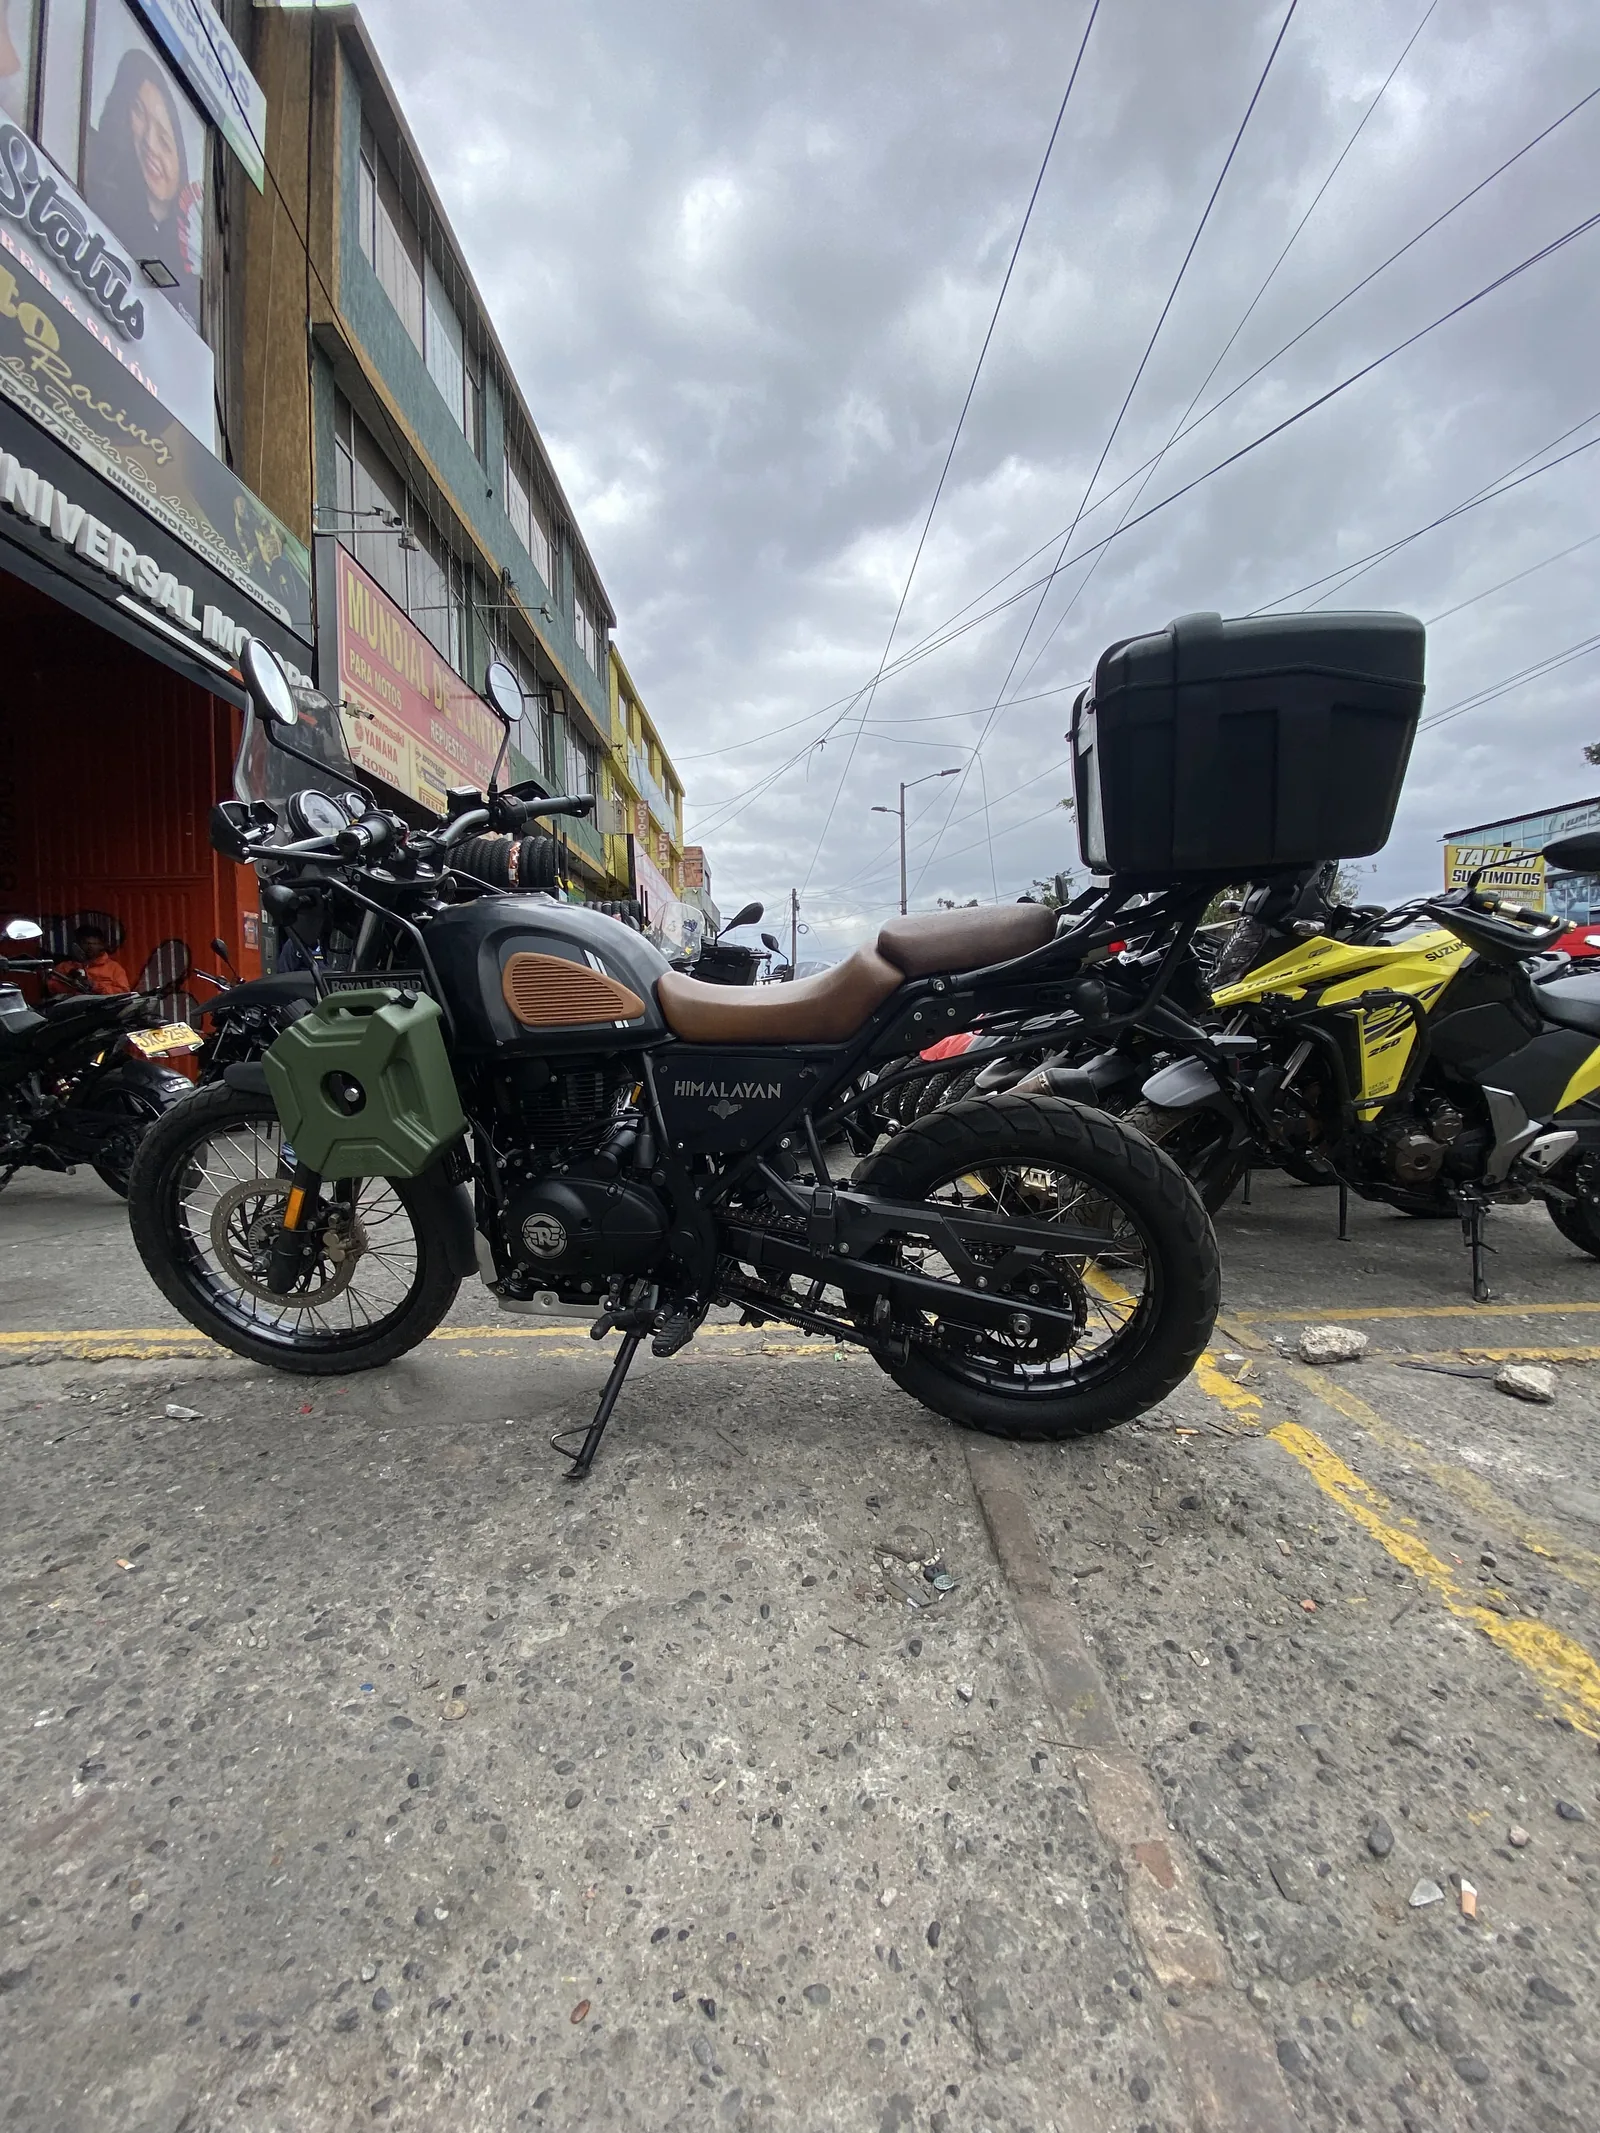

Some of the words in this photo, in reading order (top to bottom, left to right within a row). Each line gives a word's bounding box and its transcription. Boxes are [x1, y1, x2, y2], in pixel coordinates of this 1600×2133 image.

[24, 338, 172, 465] Racing
[0, 354, 39, 393] La
[44, 384, 121, 464] Tienda
[125, 456, 157, 494] De
[160, 495, 199, 530] Las
[201, 522, 251, 574] Motos
[0, 368, 82, 451] 640736
[106, 467, 282, 616] www.motoracing.com.co
[0, 446, 201, 632] NIVERSAL
[347, 568, 431, 703] MUNDIAL
[432, 659, 451, 719] DE
[456, 683, 506, 769] LLANTA
[350, 648, 373, 688] PARA
[374, 671, 402, 712] MOTOS
[364, 726, 398, 766] YAMAHA
[361, 754, 400, 788] HONDA
[636, 803, 647, 837] MOTOS
[658, 833, 668, 861] CDA
[1456, 848, 1537, 868] TALLER
[1452, 869, 1541, 886] SUTIMOTOS
[1425, 941, 1470, 962] SUZUK
[330, 979, 369, 992] ROYAL
[1367, 1037, 1402, 1058] 250
[673, 1080, 782, 1099] HIMALAYAN
